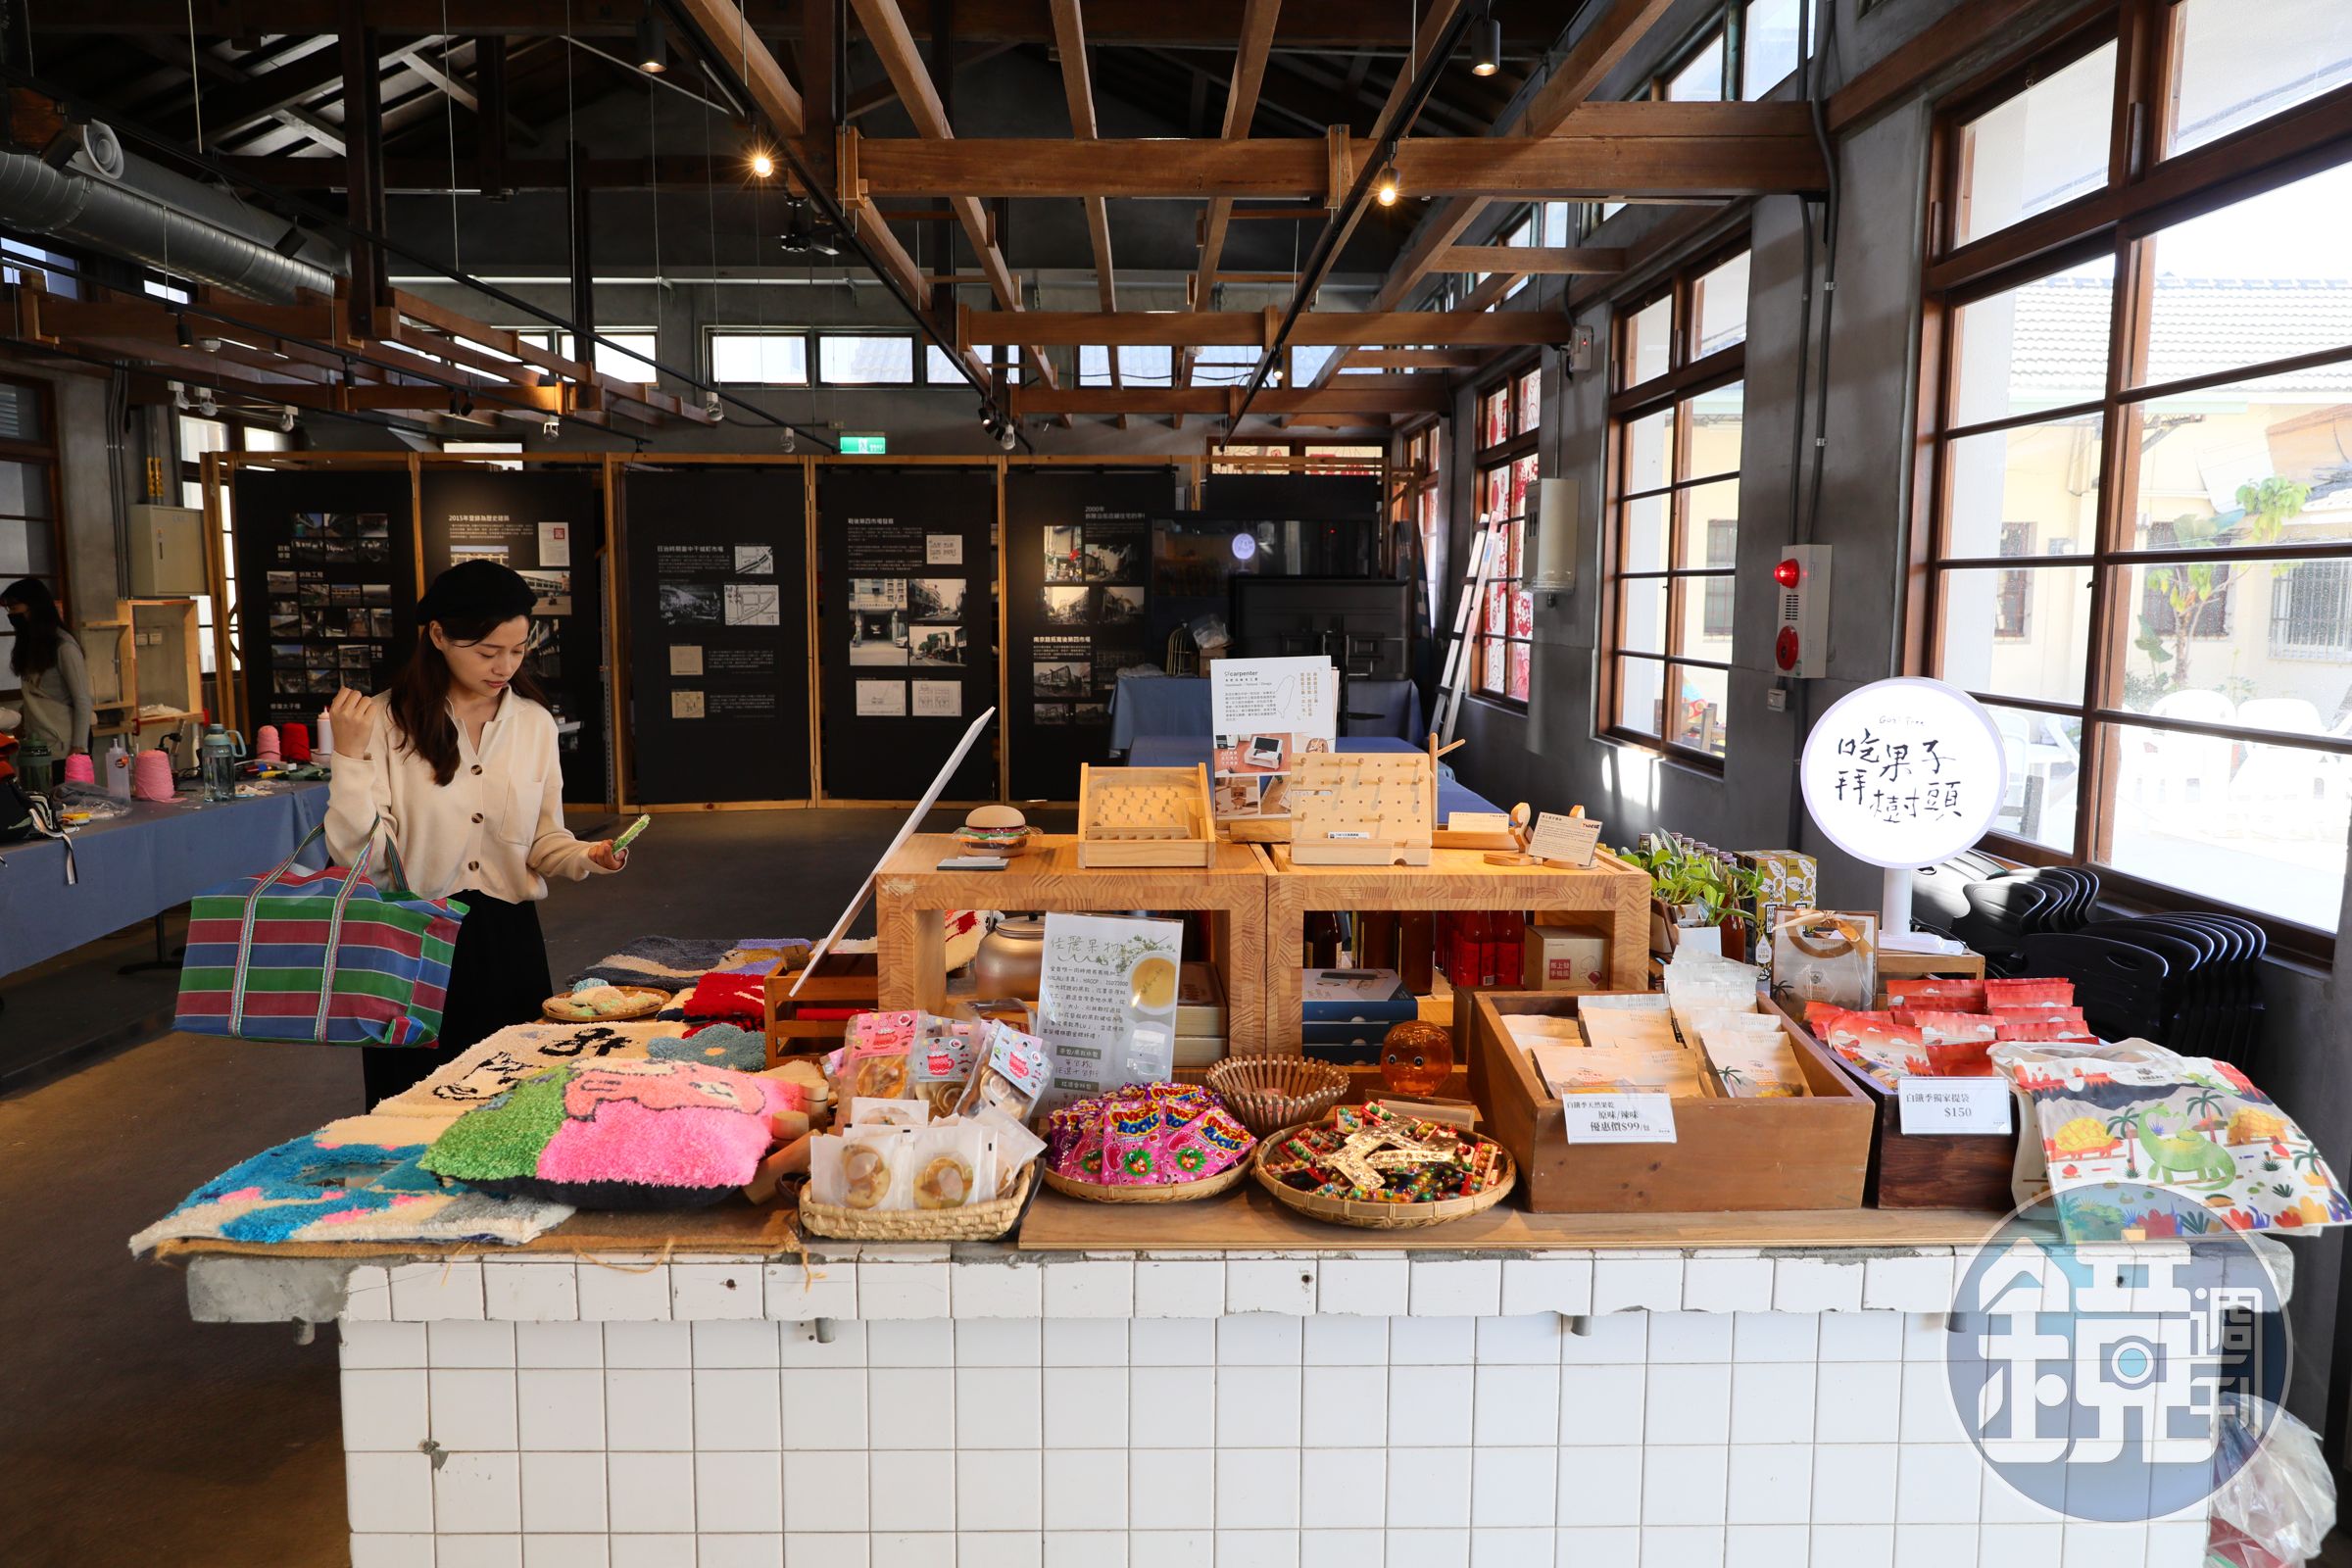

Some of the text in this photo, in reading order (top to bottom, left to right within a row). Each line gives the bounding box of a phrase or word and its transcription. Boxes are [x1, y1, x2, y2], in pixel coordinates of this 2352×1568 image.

[1838, 728, 1956, 781] 吃果子
[1835, 769, 1962, 823] 拜樹頭
[1598, 1110, 1640, 1120] 原味/辣味
[1944, 1106, 1972, 1118] $150
